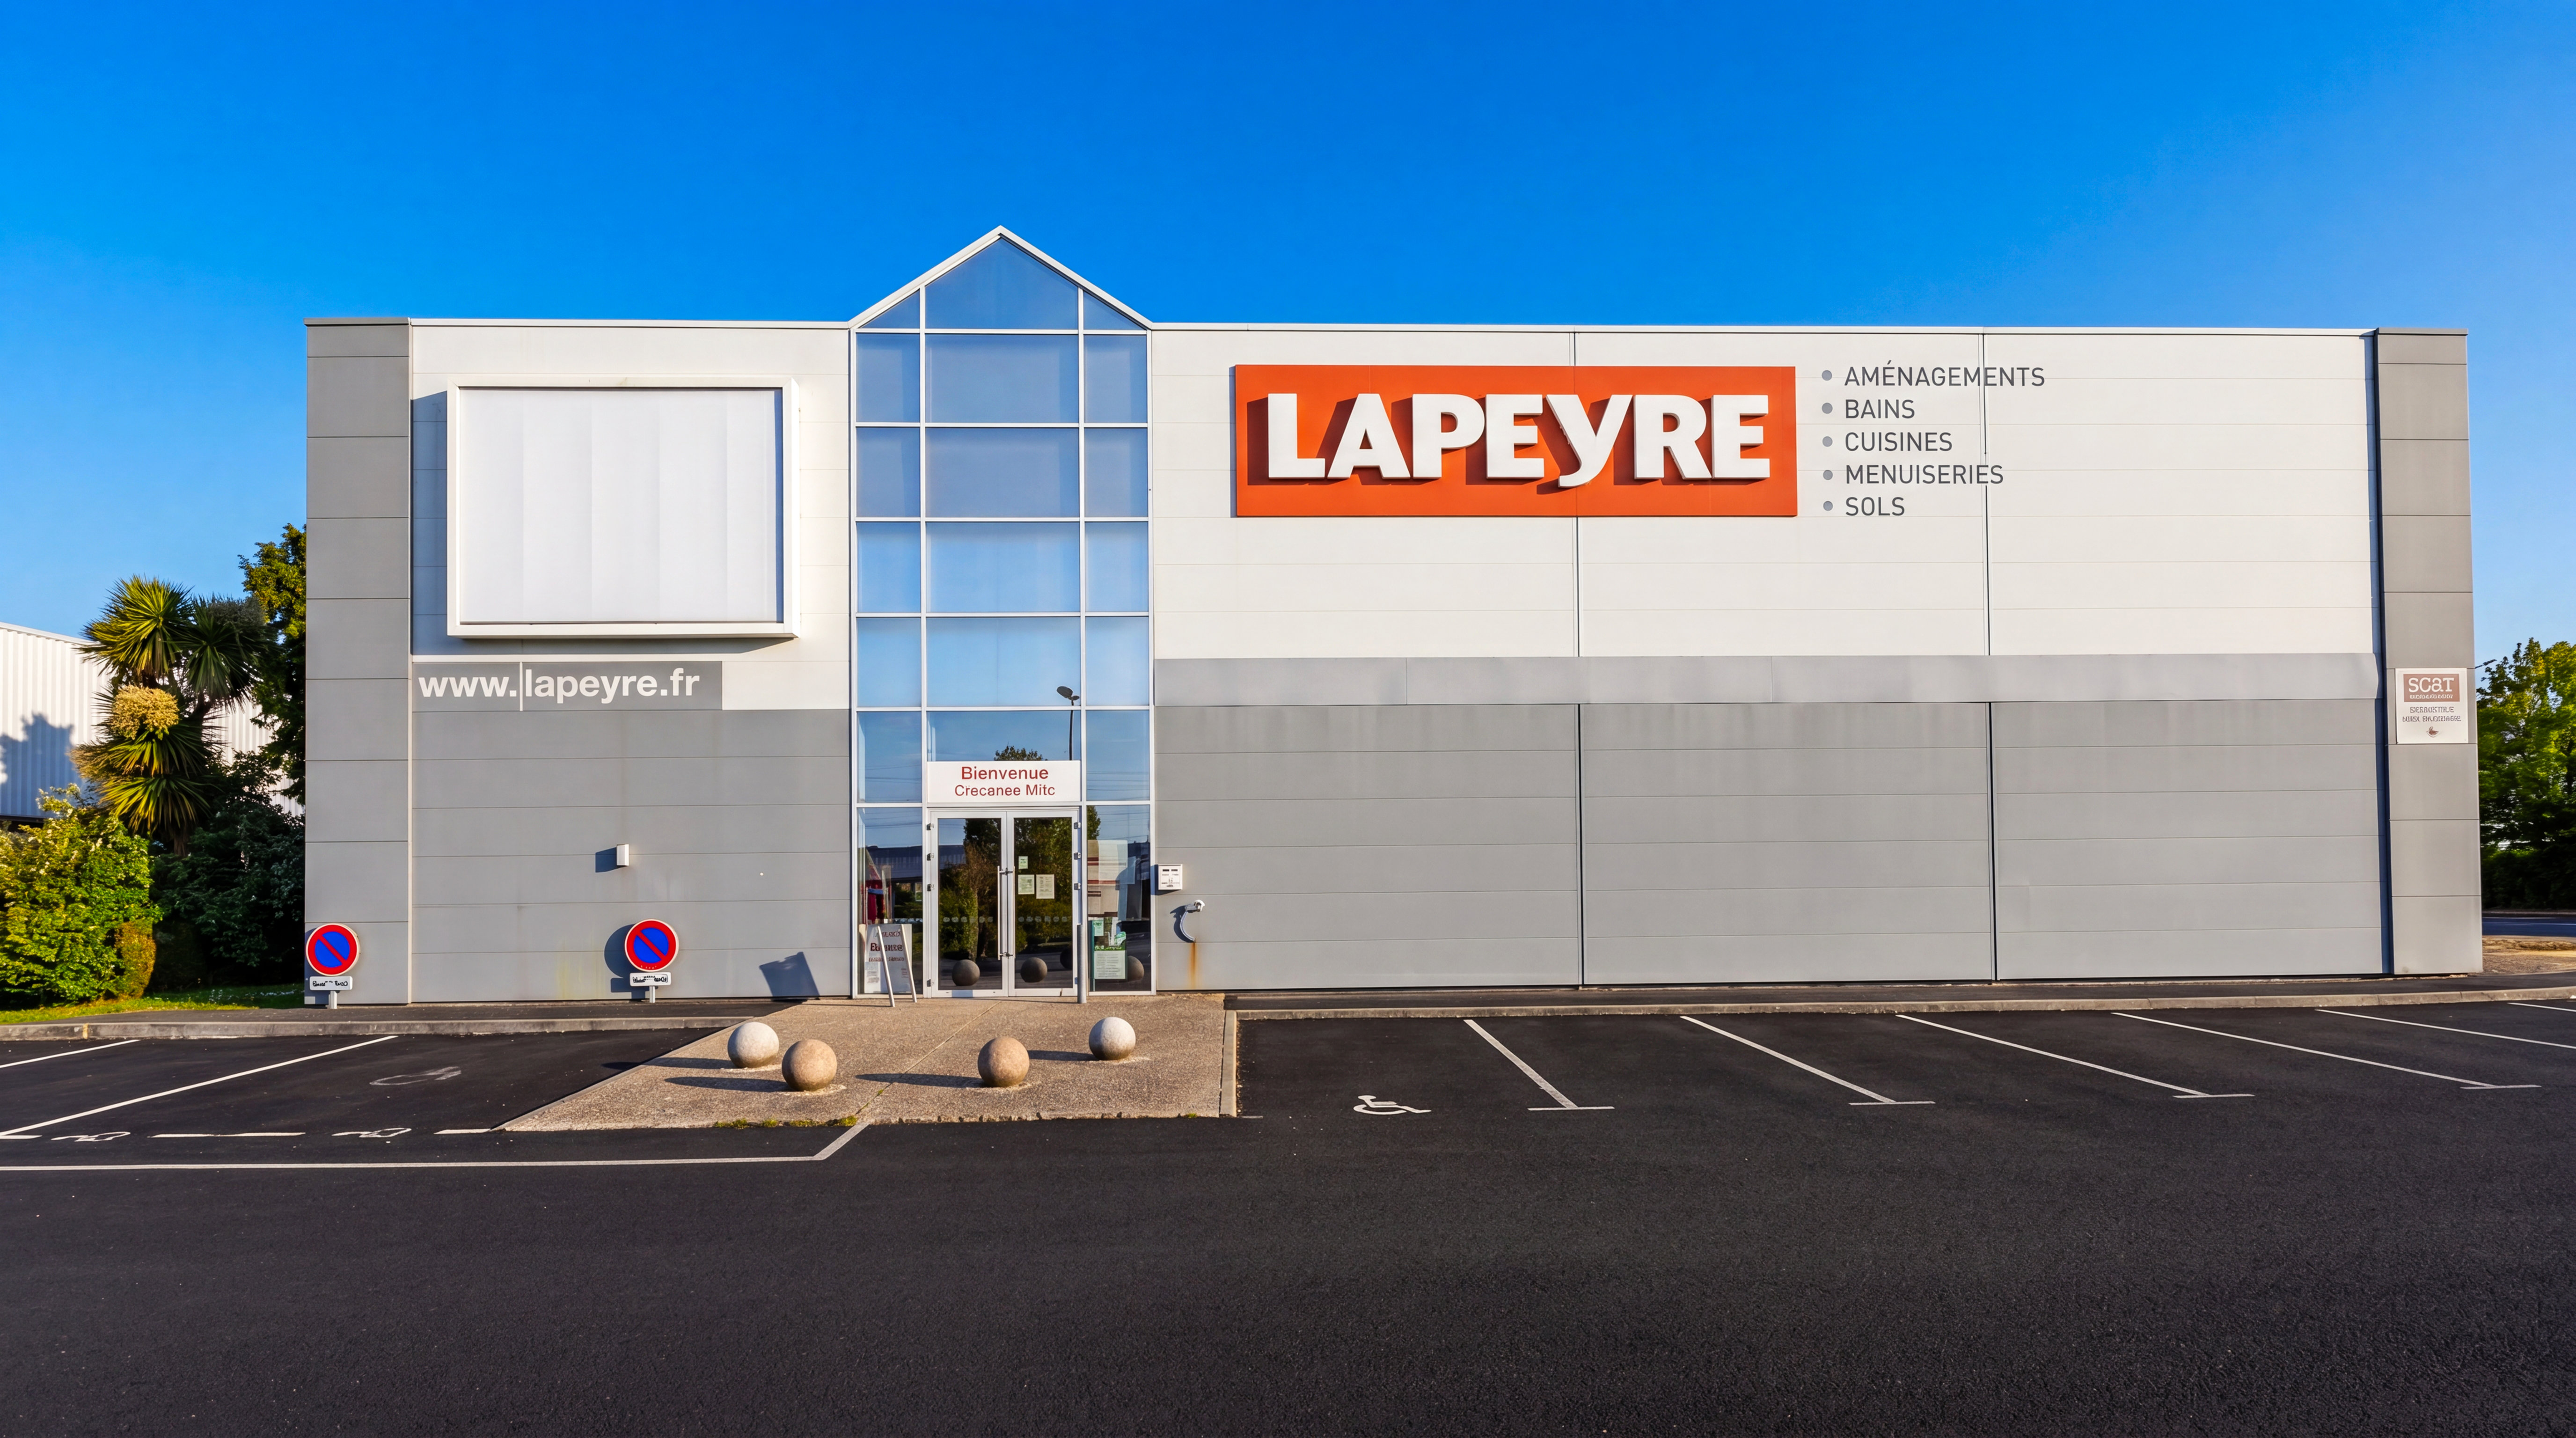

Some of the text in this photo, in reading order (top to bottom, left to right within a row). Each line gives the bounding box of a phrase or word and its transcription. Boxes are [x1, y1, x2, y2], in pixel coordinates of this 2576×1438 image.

[1844, 360, 2045, 387] AMÉNAGEMENTS
[1845, 399, 1915, 419] BAINS
[1845, 432, 1953, 451] CUISINES
[1846, 464, 2004, 484] MENUISERIES
[1845, 497, 1905, 516] SOLS
[418, 668, 700, 704] www.lapeyre.fr
[961, 766, 1049, 779] Bienvenue
